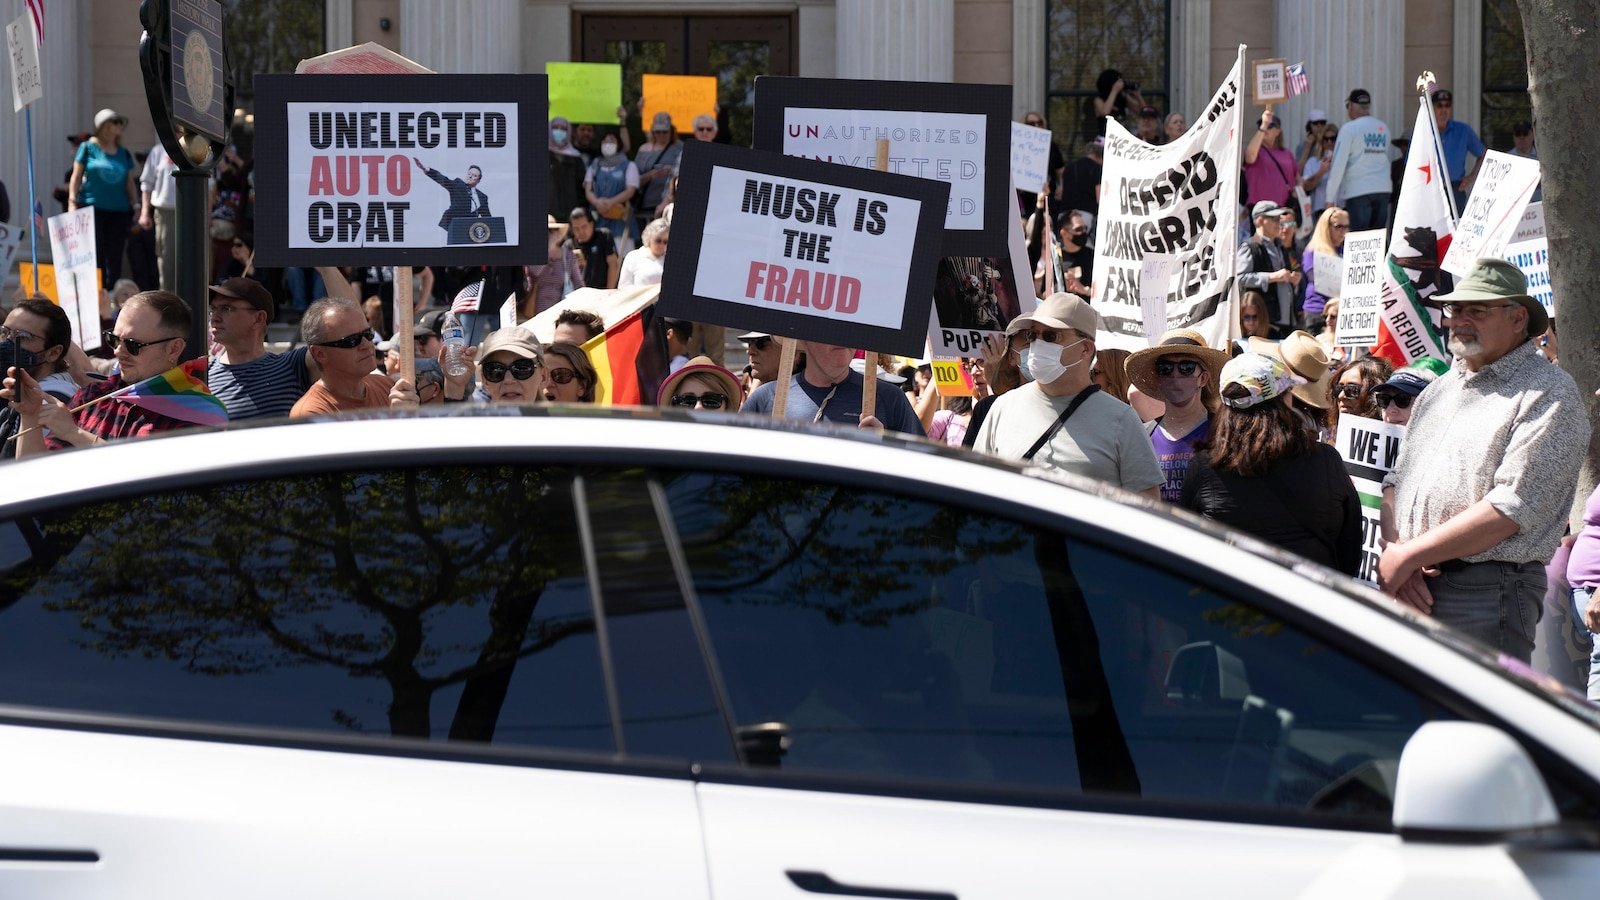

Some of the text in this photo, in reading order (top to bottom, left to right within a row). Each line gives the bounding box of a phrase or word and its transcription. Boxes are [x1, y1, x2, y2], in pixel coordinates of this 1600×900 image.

[308, 111, 507, 149] UNELECTED
[789, 124, 979, 144] UNAUTHORIZED
[308, 154, 411, 197] AUTO
[787, 154, 979, 180] VTTED
[1483, 157, 1512, 182] TRUMP
[1119, 151, 1217, 215] DEFEND
[741, 178, 888, 236] MUSK IS
[1467, 195, 1497, 223] MUSK
[308, 201, 411, 244] CRAT
[782, 228, 833, 264] THE
[1348, 237, 1381, 252] REPRODUCTIVE
[1361, 251, 1377, 264] TRANS
[745, 260, 862, 315] FRAUD
[1347, 265, 1376, 285] RIGHTS
[1352, 295, 1377, 308] STRUGGLE
[1340, 311, 1376, 330] ONE FIGHT
[1390, 311, 1430, 359] REPUB
[934, 366, 963, 382] no
[1257, 374, 1273, 397] NIKE
[1348, 427, 1380, 465] WE
